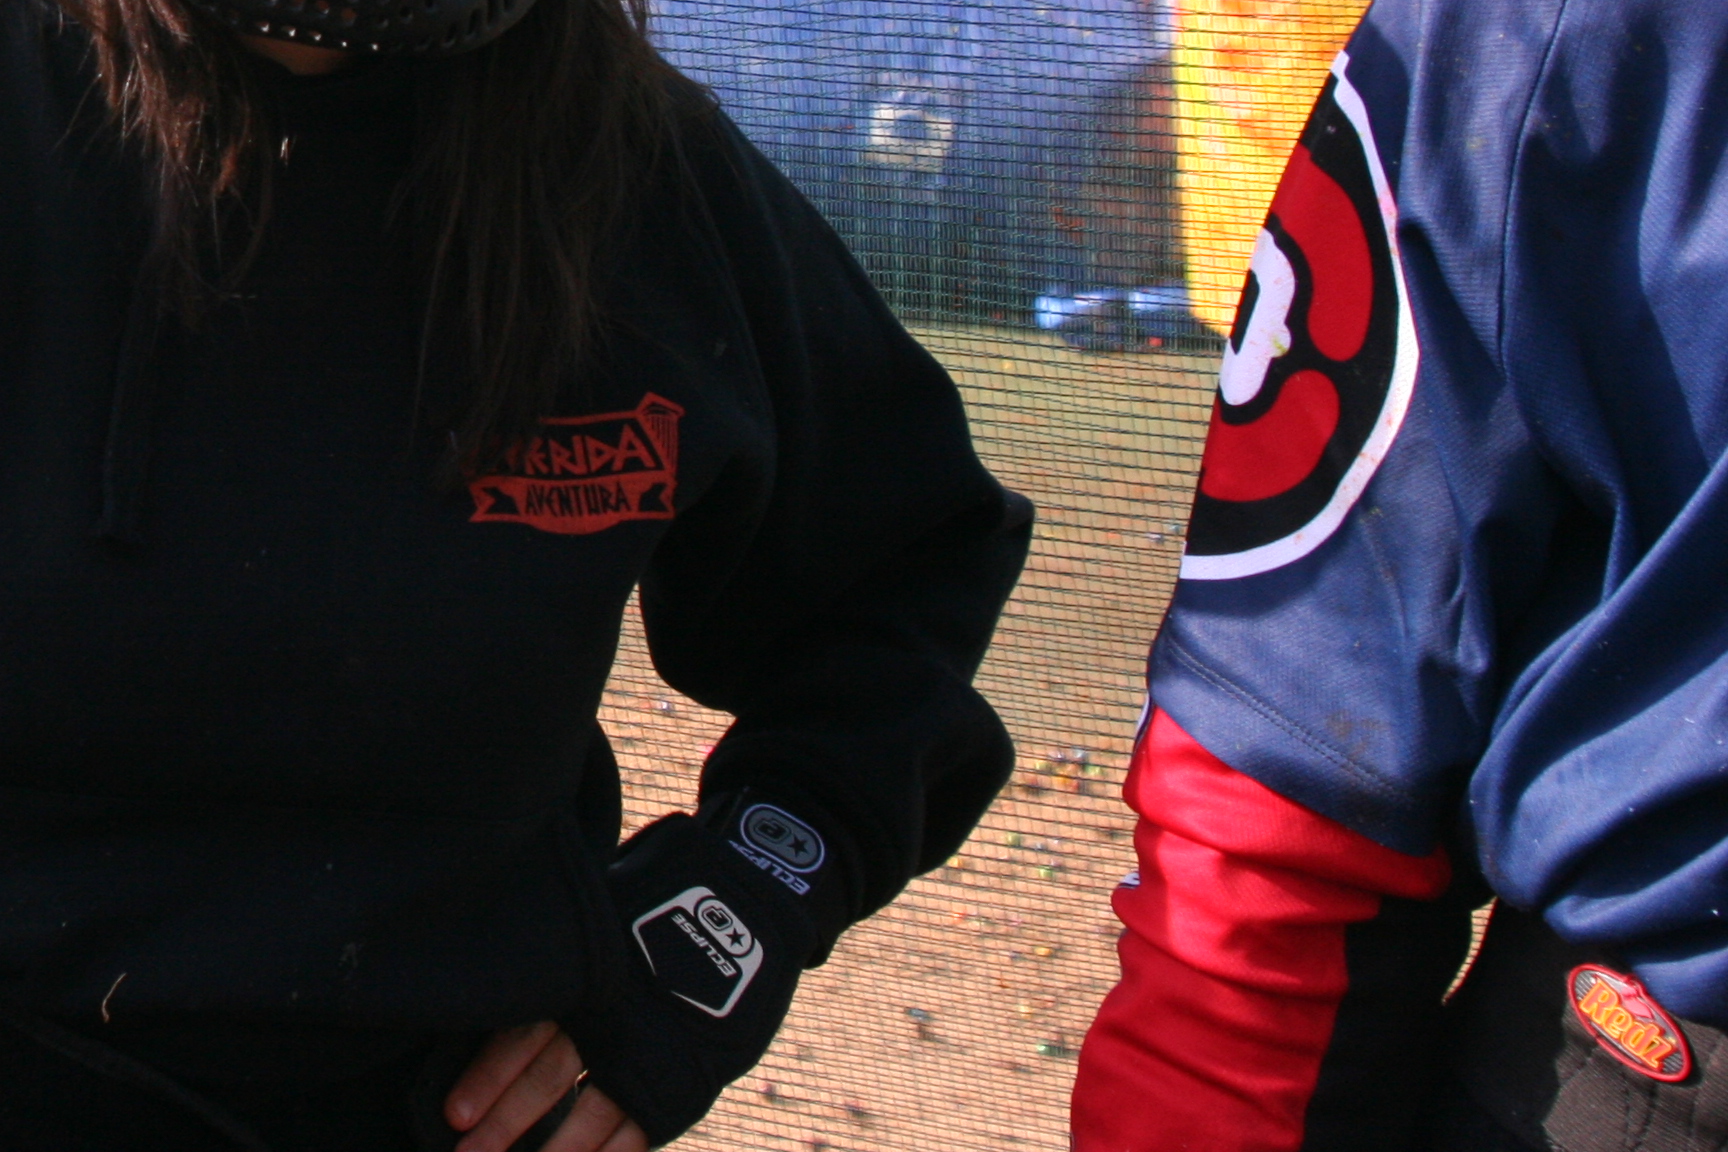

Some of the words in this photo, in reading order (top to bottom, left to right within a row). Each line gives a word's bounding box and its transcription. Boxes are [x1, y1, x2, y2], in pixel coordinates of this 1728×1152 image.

[524, 481, 632, 517] AVENTURA
[670, 912, 738, 978] ECLIPSE
[1578, 976, 1677, 1072] Redz
